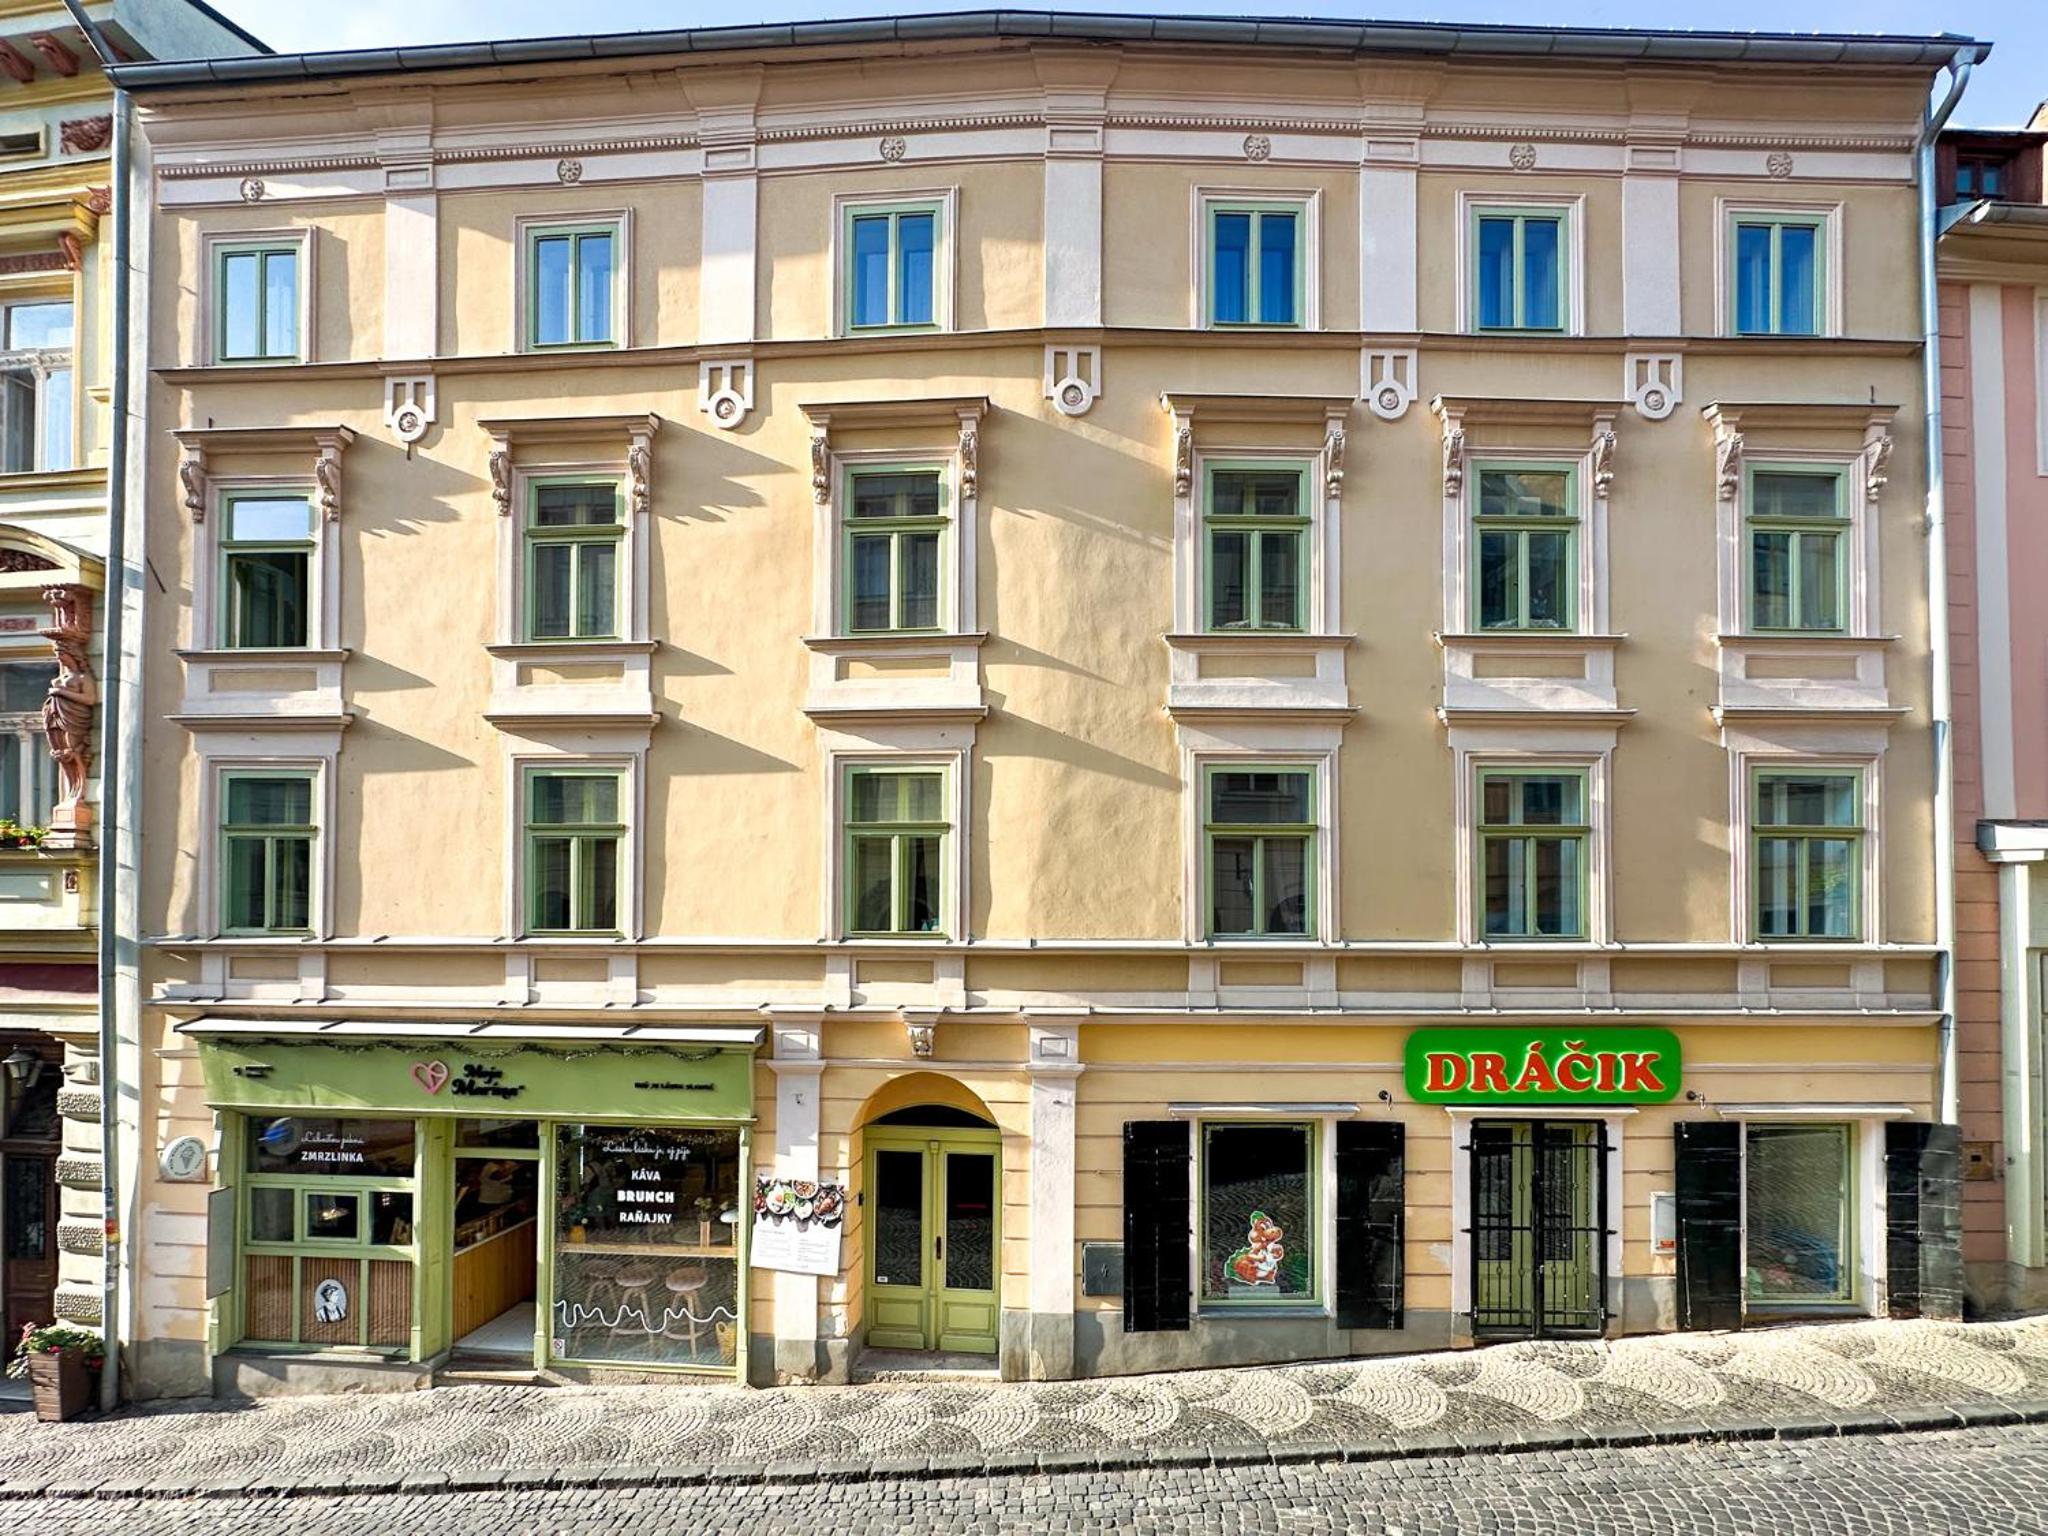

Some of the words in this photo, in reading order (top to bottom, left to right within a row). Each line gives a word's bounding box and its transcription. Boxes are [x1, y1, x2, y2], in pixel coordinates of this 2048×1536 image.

[1424, 1040, 1665, 1093] DRÁČIK
[301, 1151, 364, 1162] ZMRZLINKA
[631, 1168, 661, 1181] KÁVA
[617, 1190, 675, 1203] BRUNCH
[619, 1210, 672, 1224] RAŇAJKY
